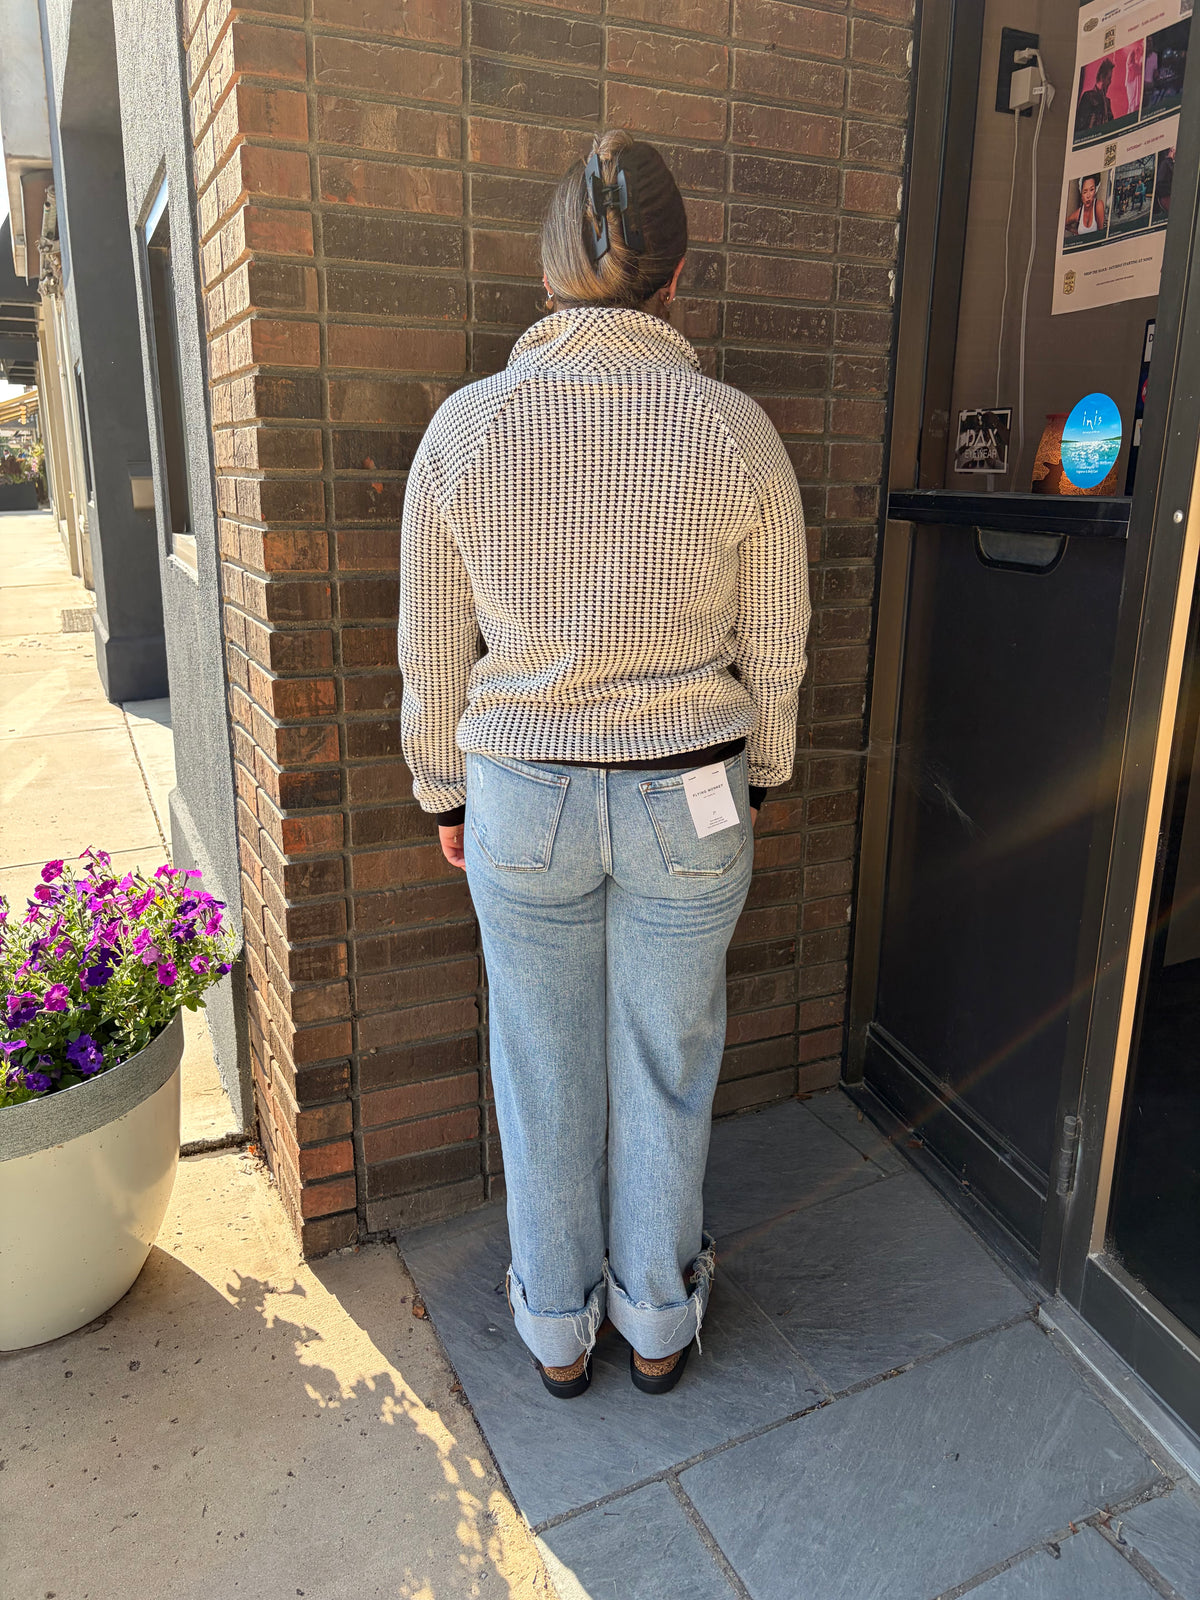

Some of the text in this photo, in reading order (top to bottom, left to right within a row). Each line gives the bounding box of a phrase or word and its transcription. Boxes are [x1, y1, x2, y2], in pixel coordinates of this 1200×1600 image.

[1082, 410, 1102, 430] inis
[966, 428, 998, 447] DAX
[964, 448, 997, 459] EYEWEAR
